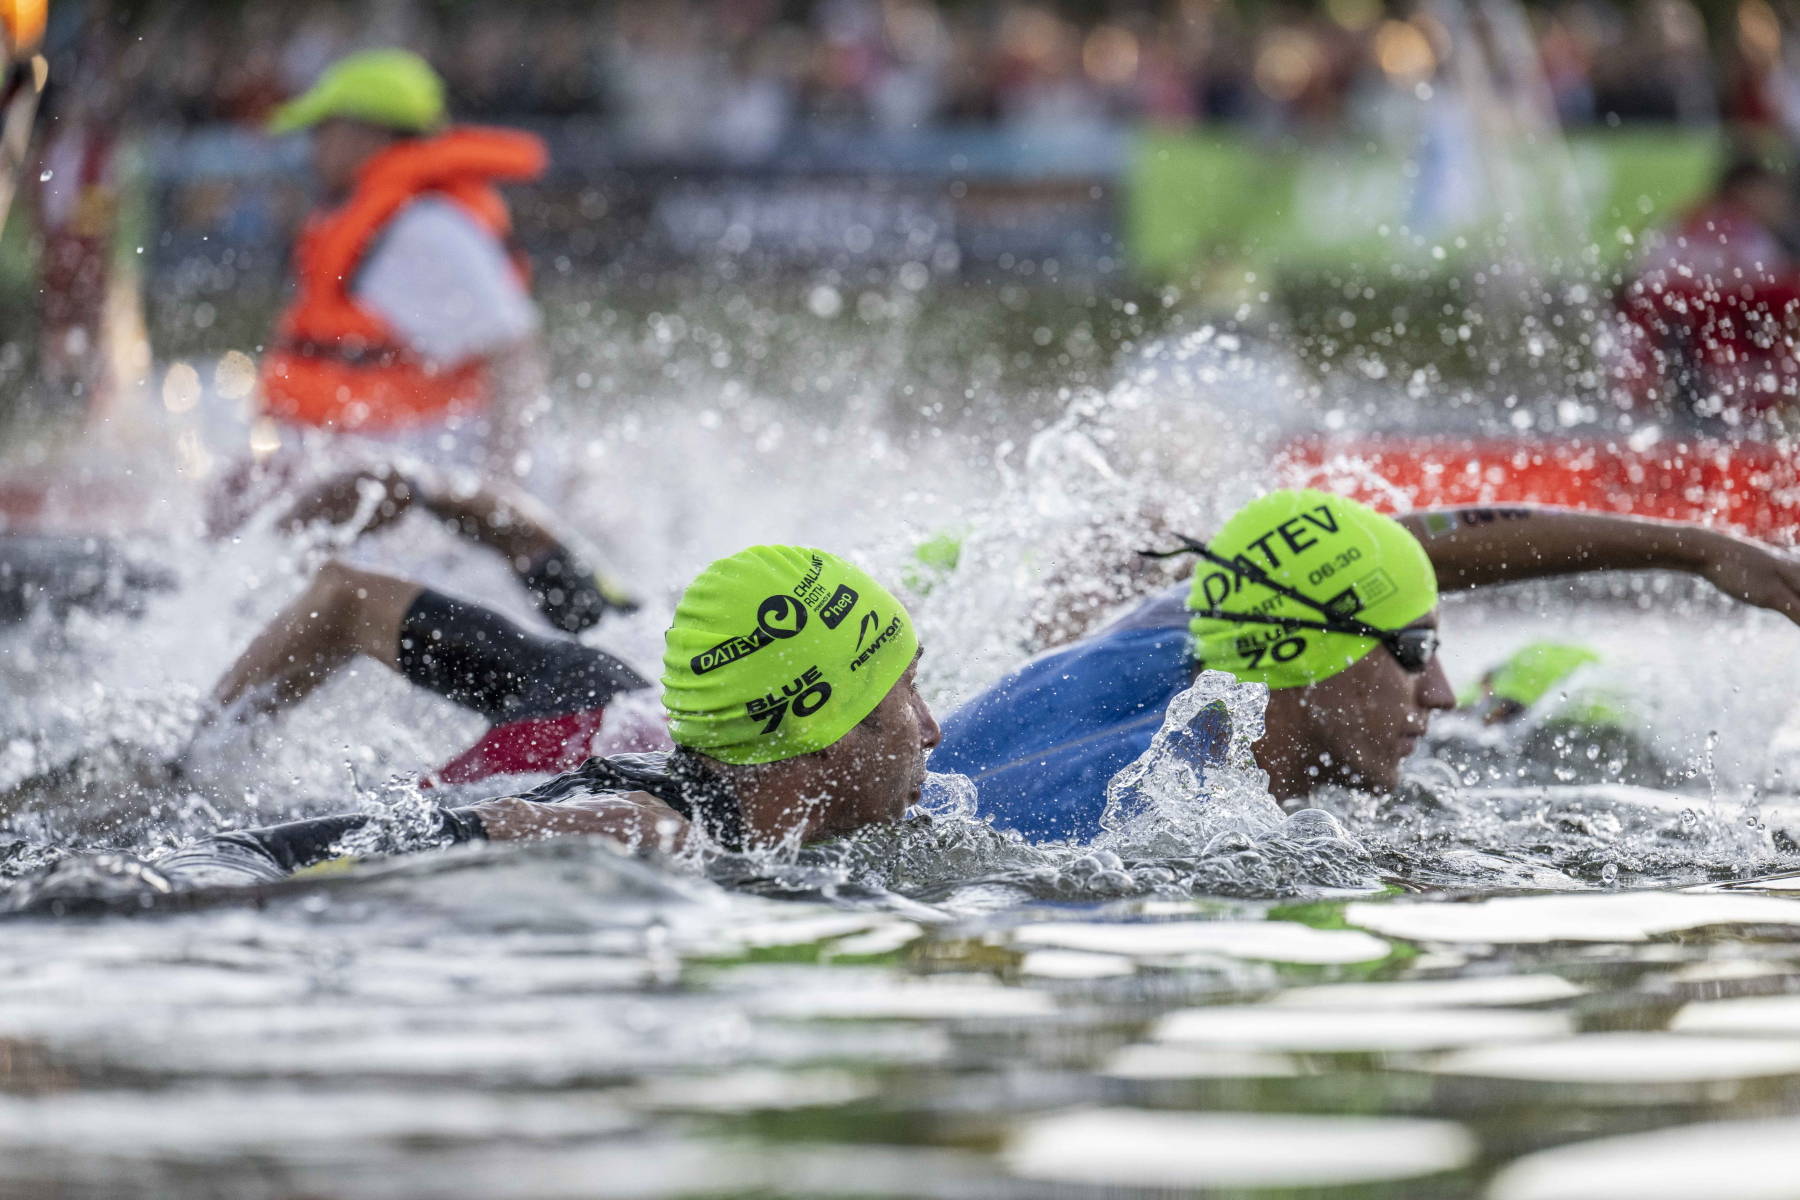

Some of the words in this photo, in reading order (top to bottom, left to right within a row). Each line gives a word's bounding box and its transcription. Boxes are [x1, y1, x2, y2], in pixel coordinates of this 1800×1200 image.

[1203, 505, 1339, 609] DATEV
[804, 584, 826, 608] ROTH
[829, 593, 852, 616] hep
[700, 634, 761, 670] DATEV
[746, 665, 824, 714] BLUE
[750, 681, 832, 735] 70
